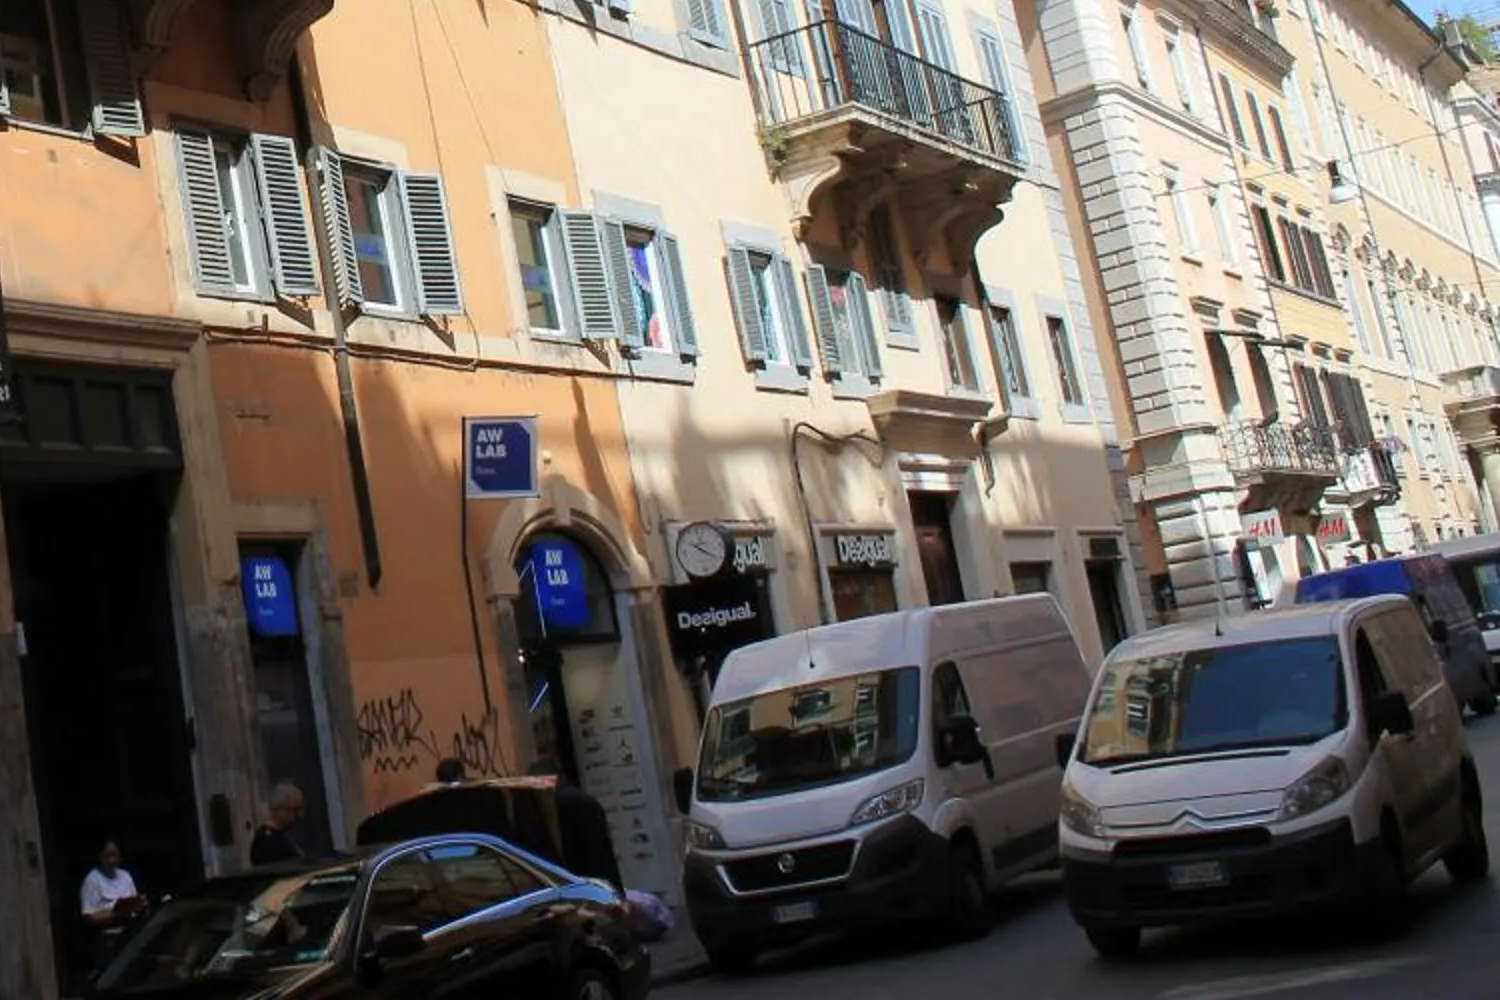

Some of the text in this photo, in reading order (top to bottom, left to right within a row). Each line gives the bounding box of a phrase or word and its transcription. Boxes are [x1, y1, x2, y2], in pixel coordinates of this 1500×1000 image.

[477, 428, 503, 443] AW
[475, 443, 507, 459] LAB
[254, 563, 274, 580] AW
[255, 582, 278, 599] LAB
